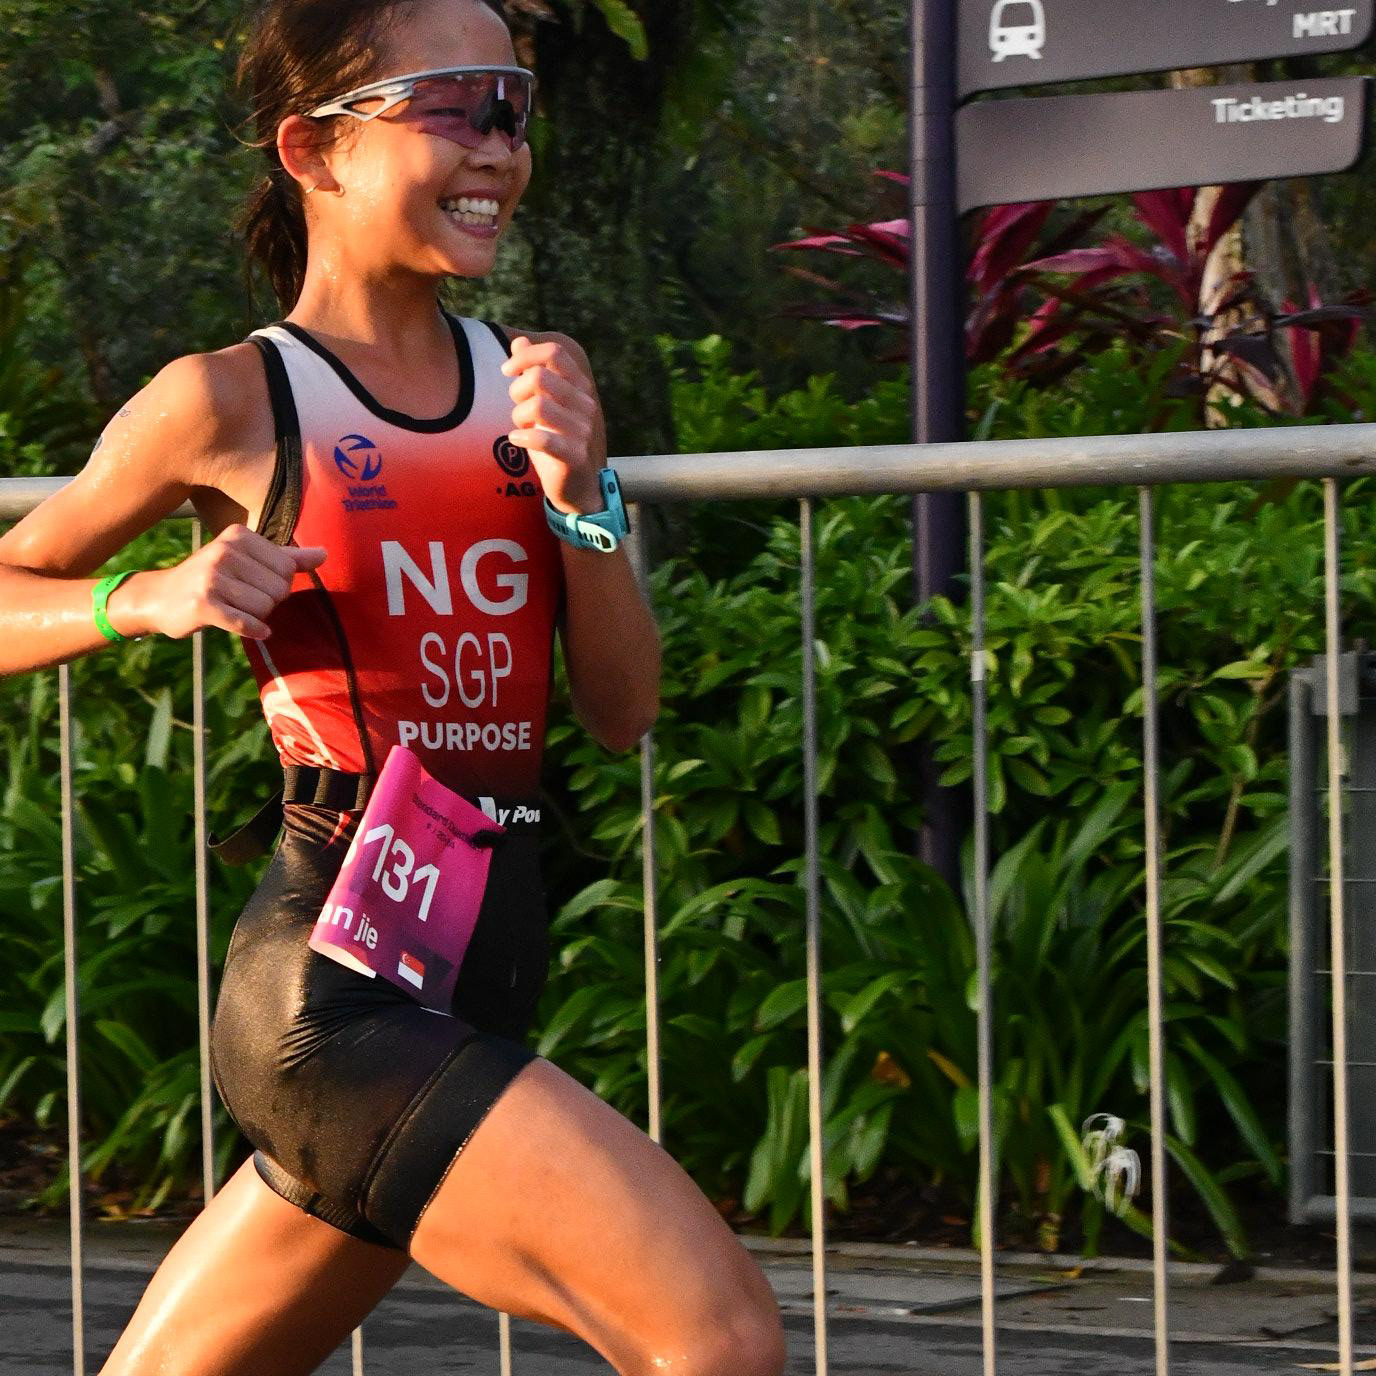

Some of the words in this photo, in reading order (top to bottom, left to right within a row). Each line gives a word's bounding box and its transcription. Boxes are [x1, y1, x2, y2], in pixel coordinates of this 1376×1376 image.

[1292, 8, 1357, 40] MRT
[1210, 92, 1346, 125] Ticketing
[380, 537, 530, 617] NG
[419, 630, 514, 710] SGP
[397, 719, 532, 752] PURPOSE
[343, 819, 441, 923] 131
[353, 911, 379, 951] jie
